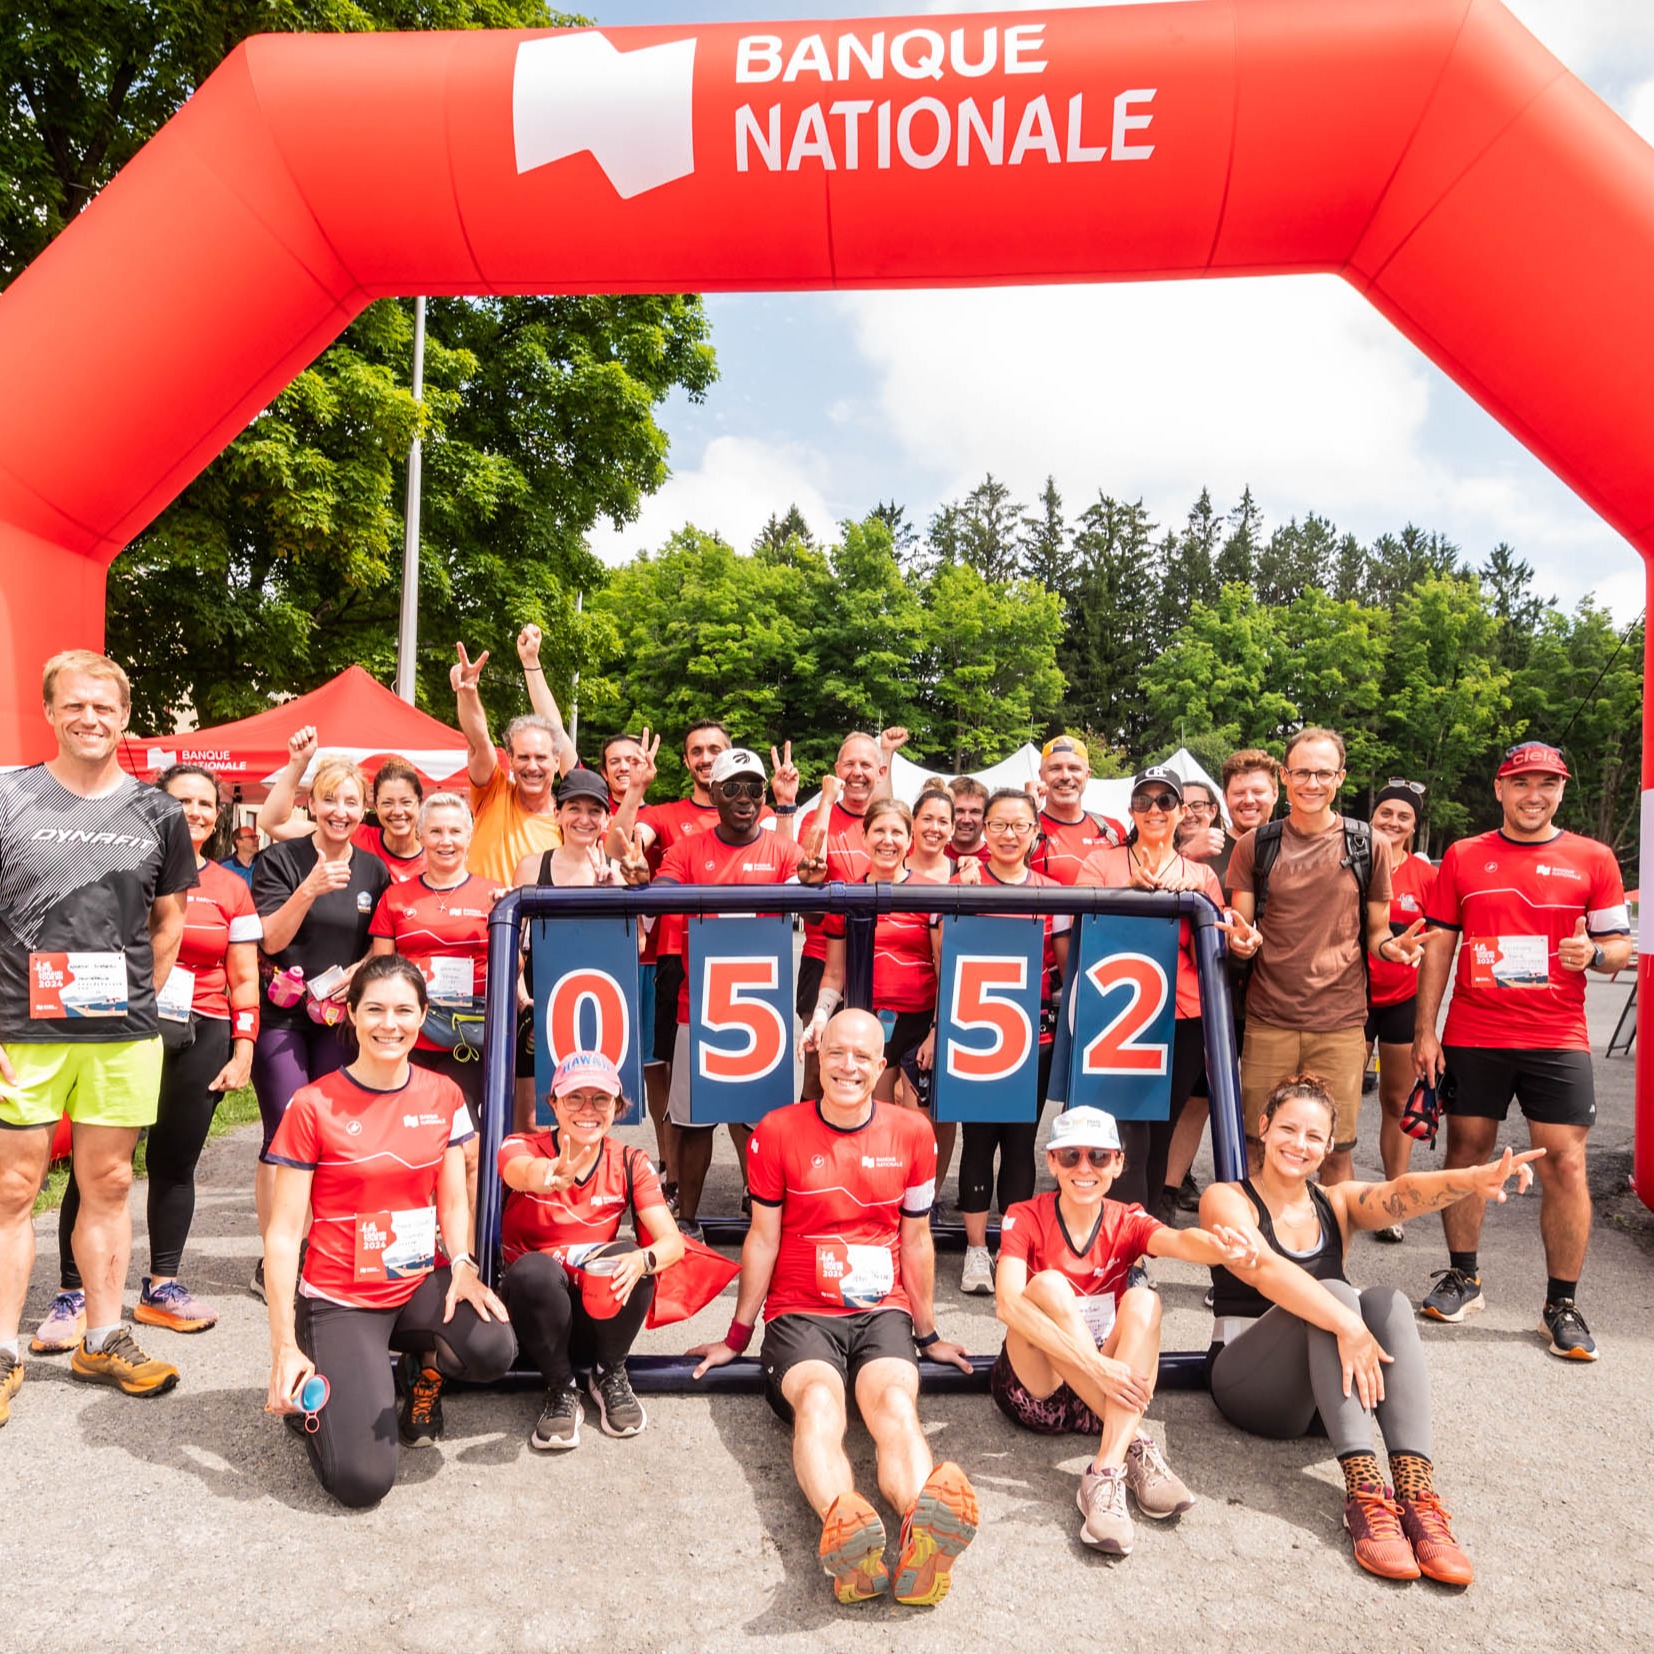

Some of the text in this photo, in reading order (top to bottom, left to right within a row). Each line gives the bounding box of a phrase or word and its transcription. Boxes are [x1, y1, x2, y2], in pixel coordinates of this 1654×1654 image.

[735, 23, 1048, 84] BANQUE
[735, 88, 1158, 171] NATIONALE
[181, 750, 231, 760] BANQUE
[1513, 747, 1559, 765] ciele
[31, 828, 154, 849] DYNAFIT
[38, 980, 64, 988] 2024
[699, 955, 787, 1083] 5
[947, 954, 1033, 1082] 5
[1083, 952, 1169, 1076] 2
[363, 1241, 387, 1250] 2024
